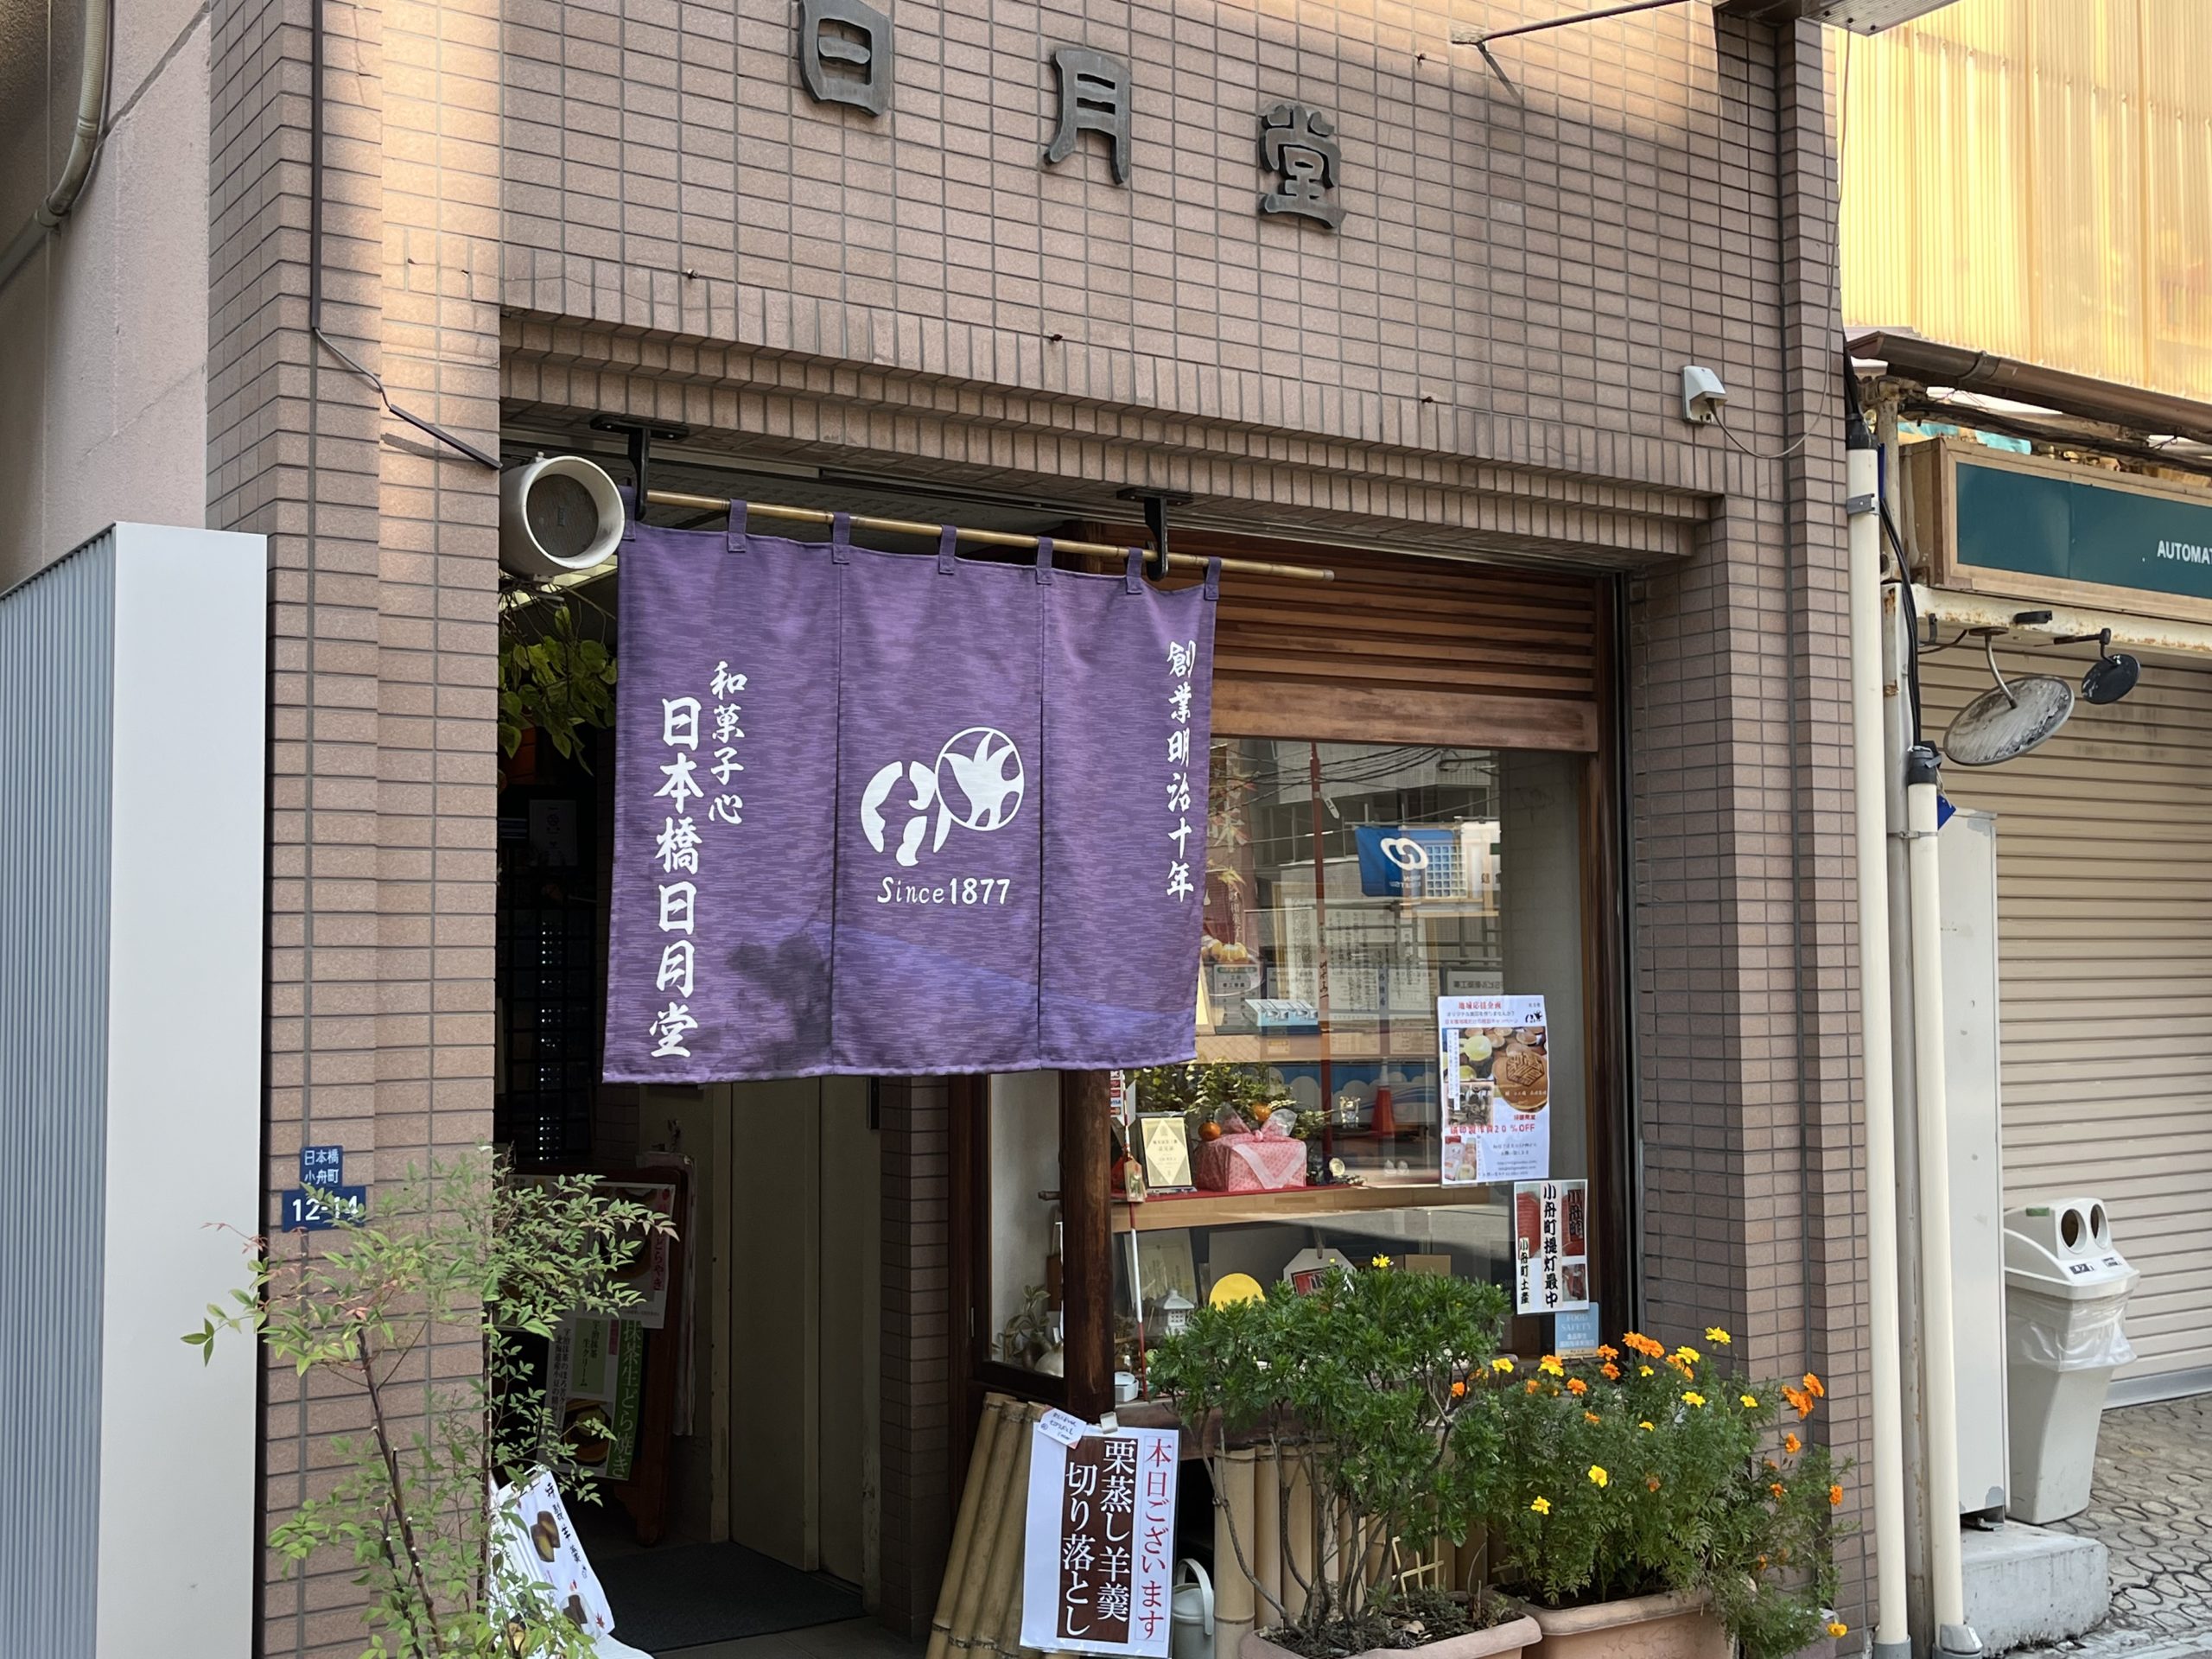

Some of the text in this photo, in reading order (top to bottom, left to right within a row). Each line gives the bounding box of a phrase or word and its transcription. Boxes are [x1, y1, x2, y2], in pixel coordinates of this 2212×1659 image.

[798, 0, 1346, 230] 日月堂
[709, 661, 747, 824] 和菓子心
[1166, 640, 1196, 903] 創業明治十年
[649, 696, 704, 1058] 日本橋日月堂
[304, 1148, 339, 1166] 日本橋
[304, 1168, 339, 1185] 小舟町
[1519, 1237, 1529, 1305] 小舟町土産
[1543, 1183, 1558, 1309] 小舟町提灯最中
[613, 1319, 642, 1478] 抹茶生どら焼き
[1062, 1461, 1098, 1637] 切り落とし
[1096, 1439, 1136, 1623] 栗蒸し羊羹
[1137, 1438, 1173, 1640] 本日ございます
